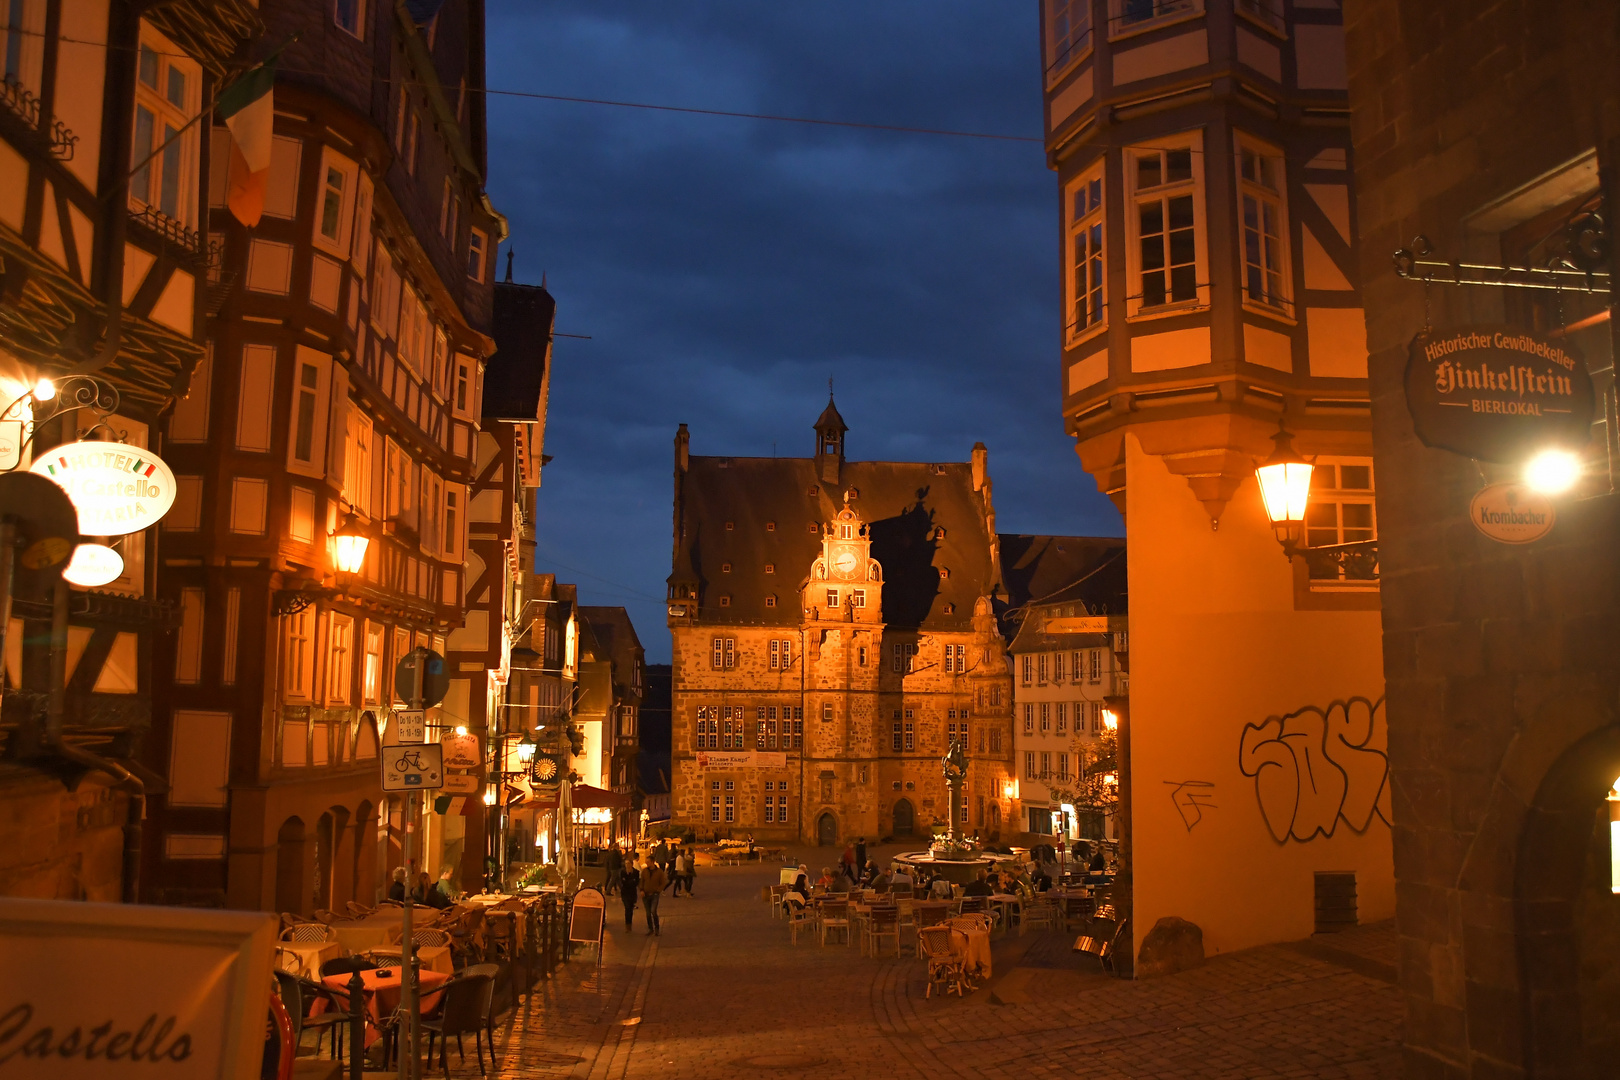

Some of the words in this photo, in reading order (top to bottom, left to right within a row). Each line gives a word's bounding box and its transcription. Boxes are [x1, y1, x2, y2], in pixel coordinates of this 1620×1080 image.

[1424, 333, 1492, 362] Historischer
[1494, 332, 1576, 371] Gewölbekeller
[1471, 399, 1543, 417] BIERLOKAL
[70, 452, 133, 474] HOTEL
[82, 479, 160, 498] Castello
[83, 501, 148, 524] STARIA
[1481, 506, 1547, 526] Krombacher
[0, 1003, 193, 1063] Castello
